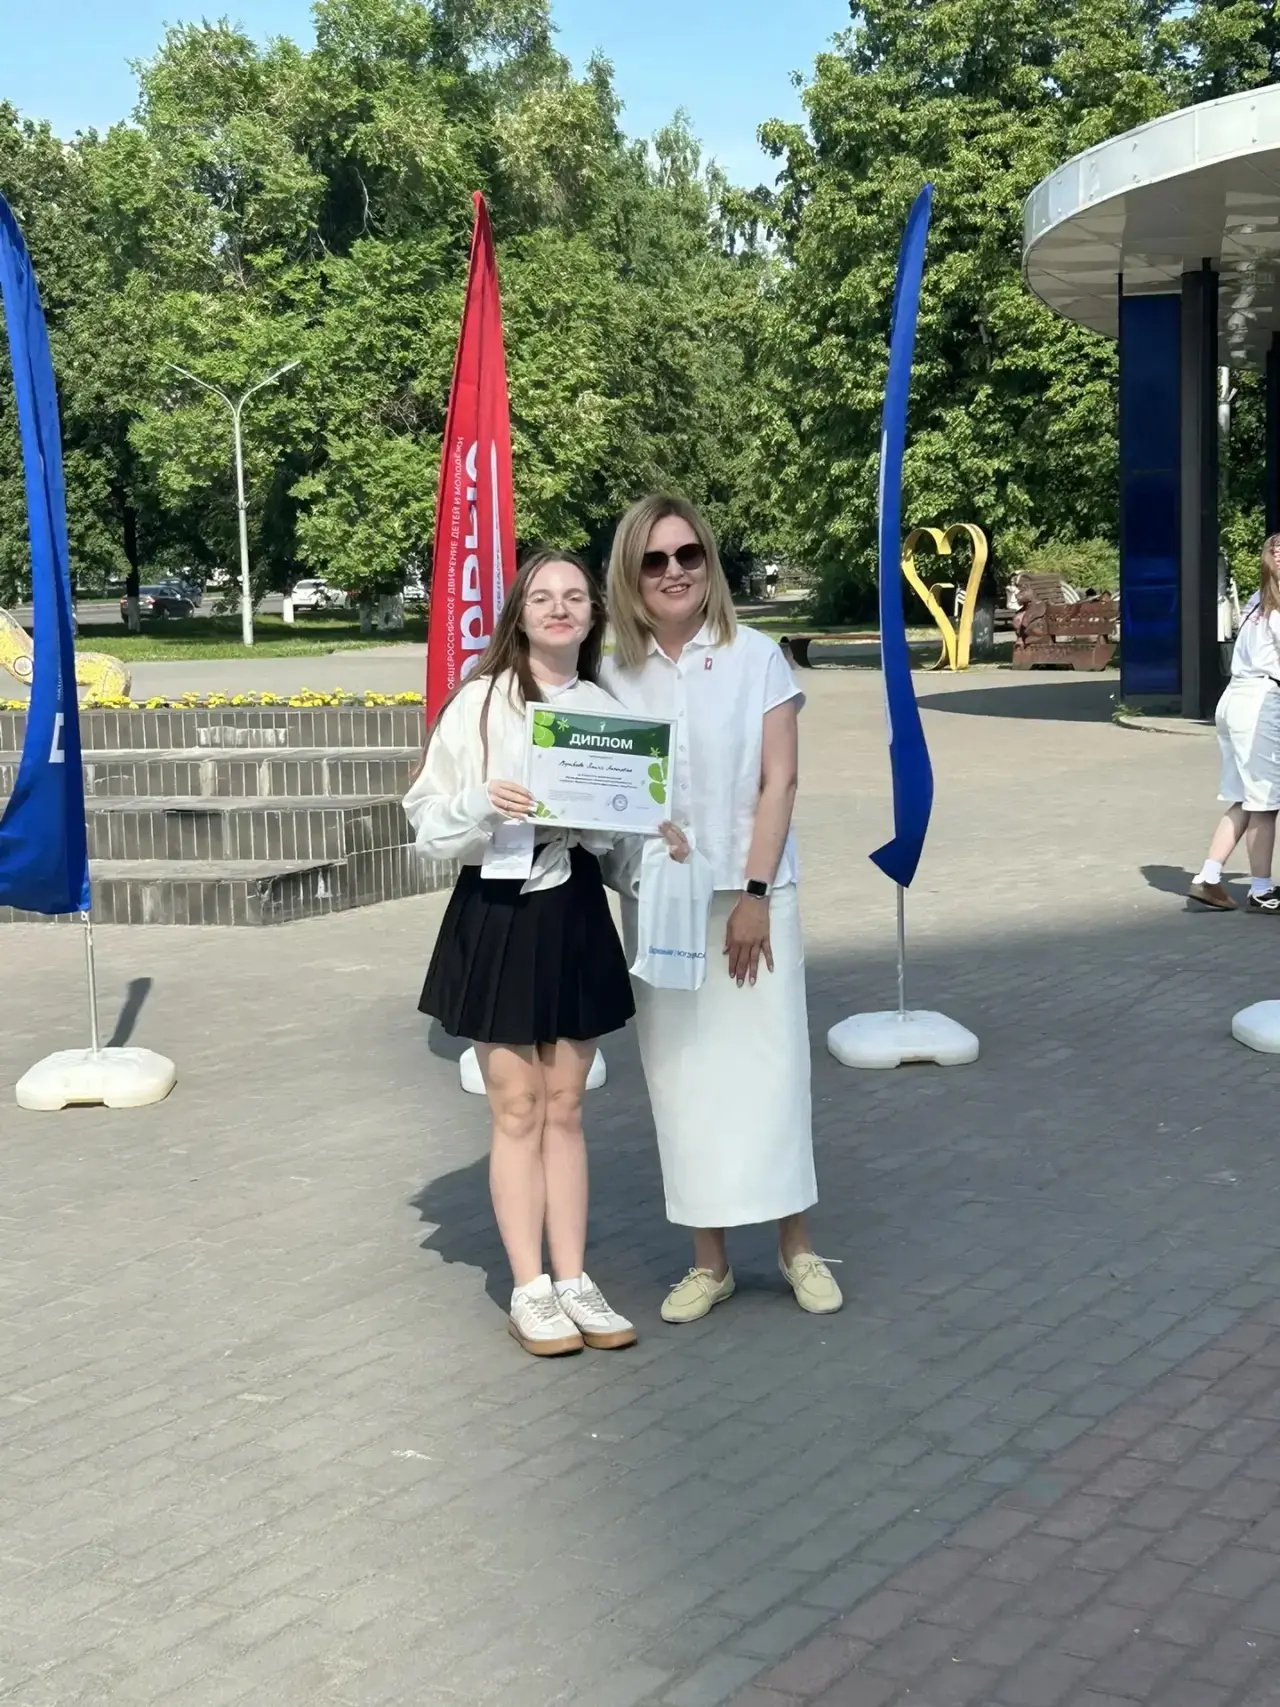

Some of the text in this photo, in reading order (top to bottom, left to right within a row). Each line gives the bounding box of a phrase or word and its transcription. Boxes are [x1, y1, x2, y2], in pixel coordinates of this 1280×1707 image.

[451, 507, 460, 539] ДЕТЕЙ
[447, 541, 458, 595] ДВИЖЕНИЕ
[446, 597, 456, 690] ОБЩЕРОССИЙСКОЕ
[569, 733, 633, 750] ДИПЛОМ
